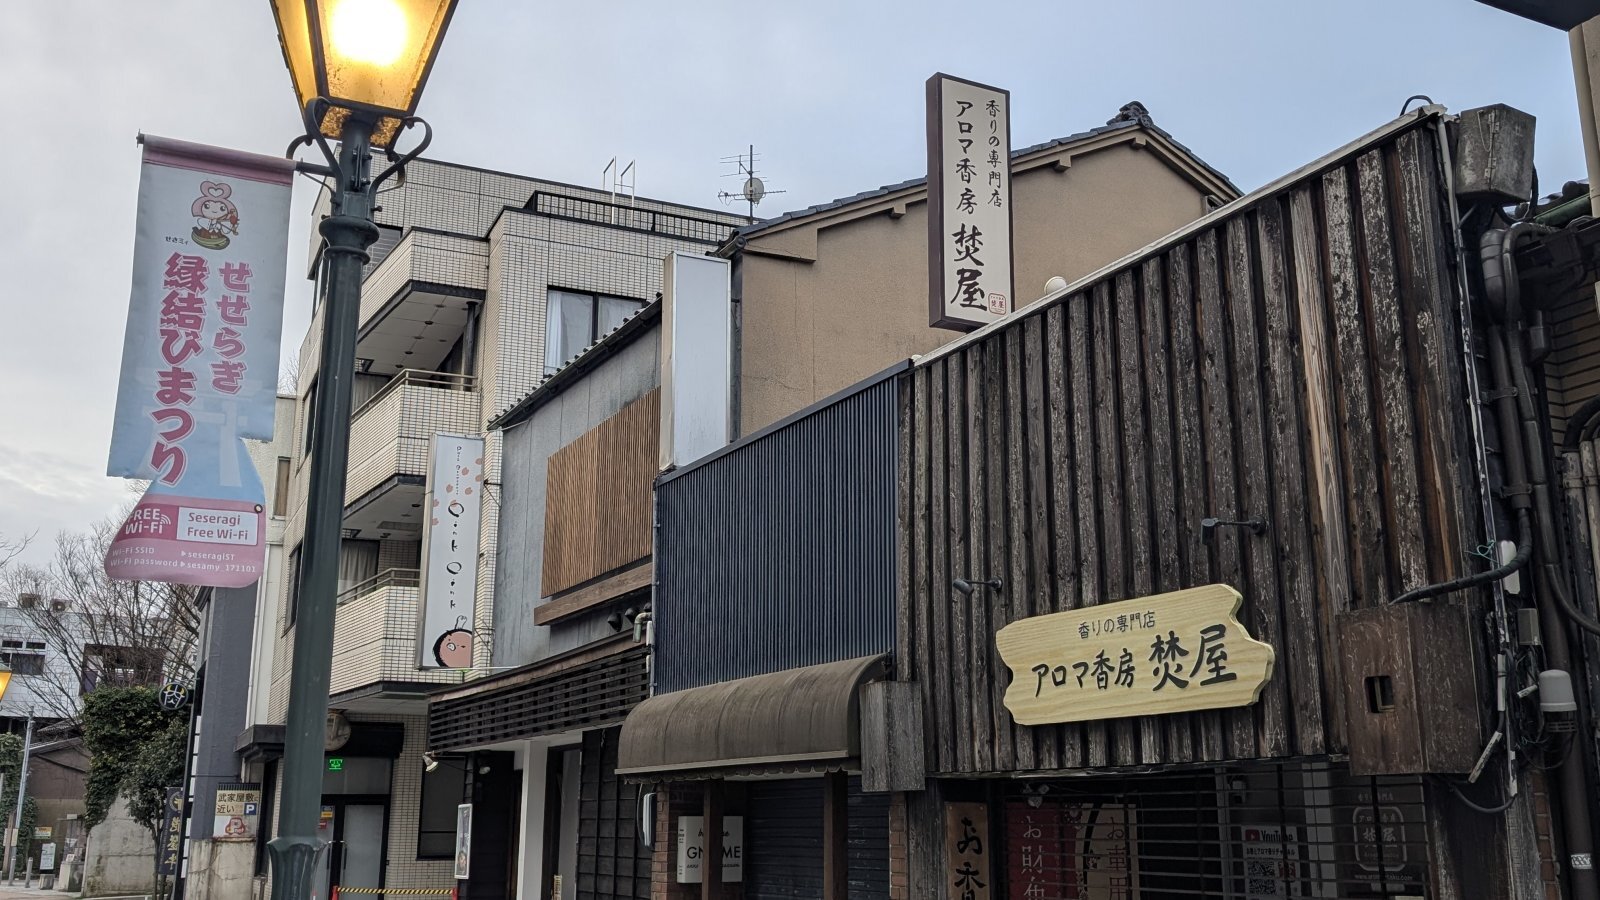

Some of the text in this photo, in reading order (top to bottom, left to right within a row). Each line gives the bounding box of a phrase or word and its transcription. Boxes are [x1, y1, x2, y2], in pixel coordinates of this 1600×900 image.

[985, 100, 1002, 207] 香りの専門店
[951, 100, 988, 311] アロマ香房 焚屋
[210, 261, 252, 396] せせらぎ
[150, 251, 210, 486] 縁結びまつり
[128, 508, 161, 523] FREE
[188, 512, 241, 527] Seseragi
[125, 522, 164, 535] Wi-Fi
[187, 527, 248, 540] Free Wi-Fi
[134, 559, 178, 568] password
[1078, 611, 1156, 639] 香りの専門店
[1031, 624, 1237, 698] アロマ香房 焚屋
[217, 804, 235, 814] 近い
